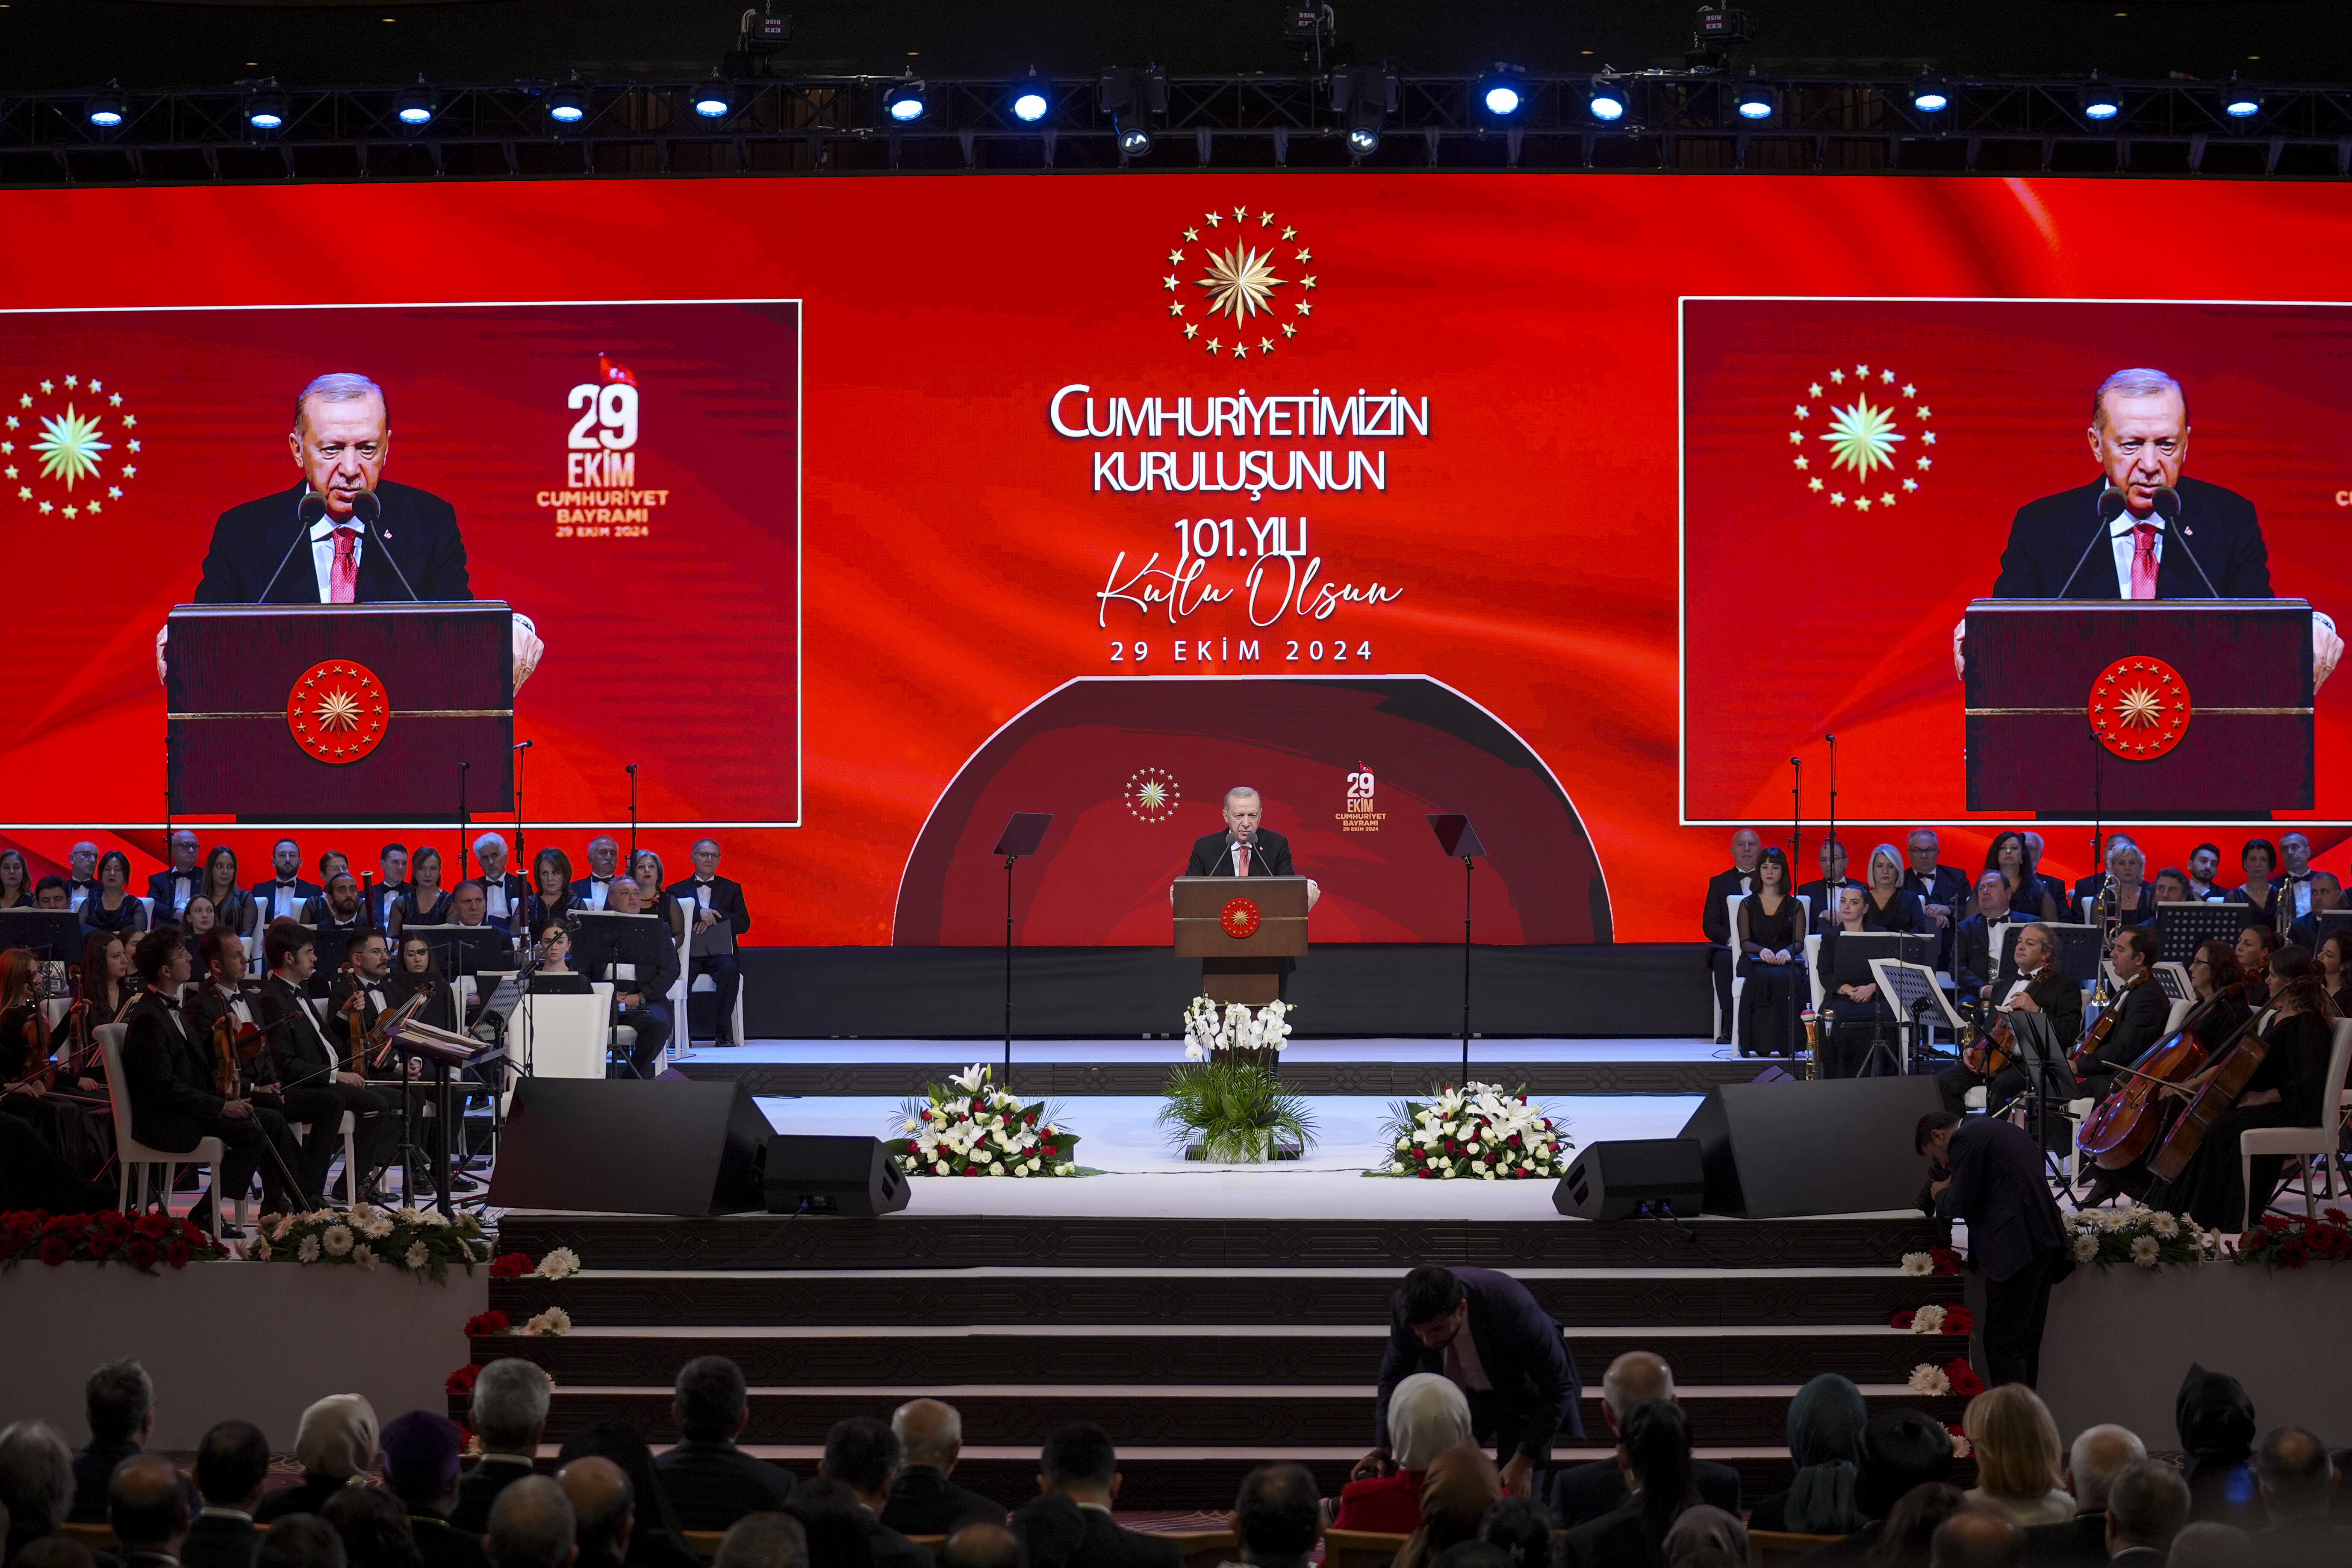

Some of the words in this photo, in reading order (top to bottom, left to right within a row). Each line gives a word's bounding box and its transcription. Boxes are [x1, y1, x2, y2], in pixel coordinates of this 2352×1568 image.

[567, 383, 639, 449] 29
[1050, 383, 1428, 438] CUMHURİYETİMİZİN
[567, 448, 636, 488] EKİM
[1094, 450, 1385, 501] KURULUŞUNUN
[536, 488, 669, 507] CUMHURİYET
[556, 508, 648, 524] BAYRAMI
[1096, 551, 1234, 628] Kutlu
[1245, 550, 1403, 627] Olsun
[1110, 641, 1148, 661] 29
[1174, 637, 1259, 661] EKİM
[1285, 640, 1371, 660] 2024
[1347, 772, 1374, 798] 29
[1347, 797, 1373, 813] EKİM
